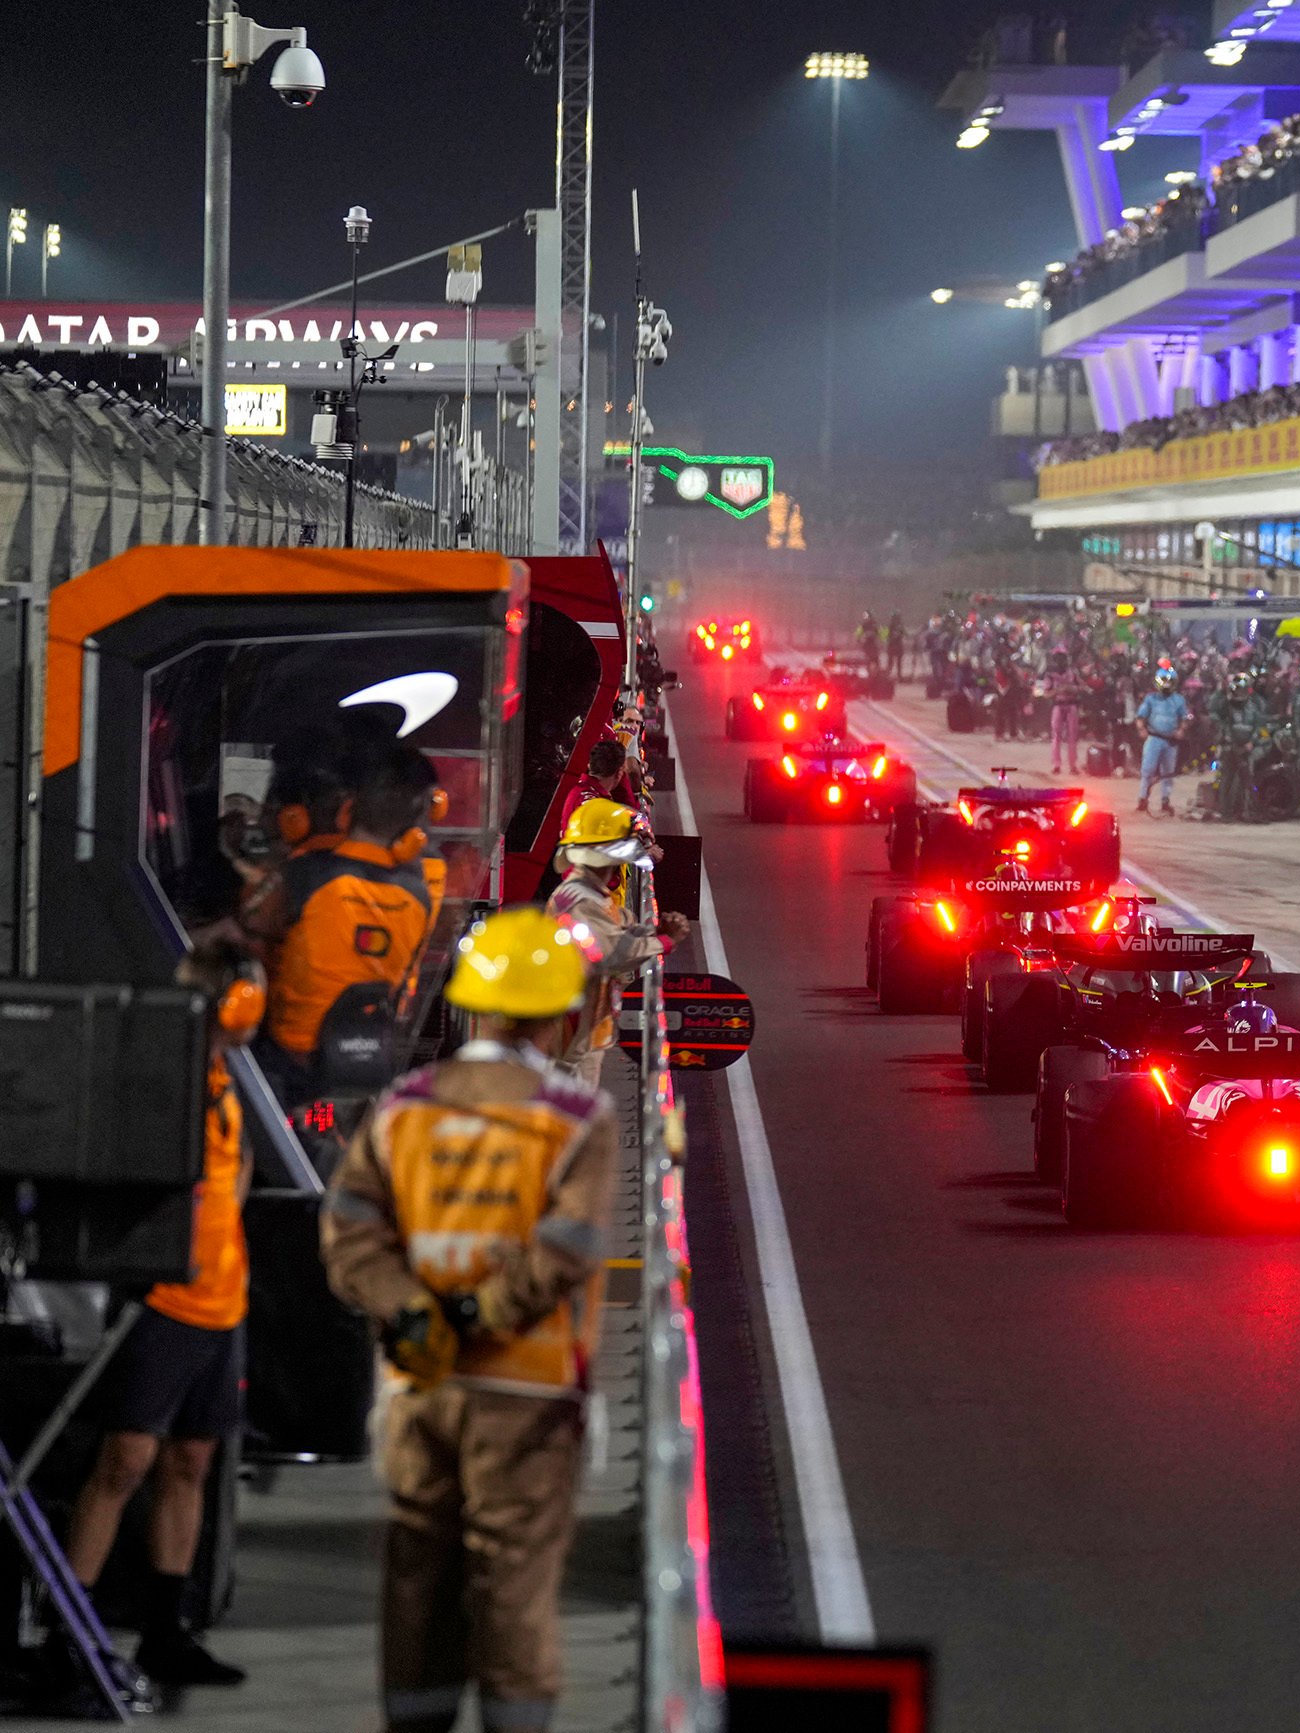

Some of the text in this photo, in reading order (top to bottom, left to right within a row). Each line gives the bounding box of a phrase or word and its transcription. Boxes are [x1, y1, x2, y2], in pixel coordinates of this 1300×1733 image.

[0, 314, 160, 348] ATAR
[975, 880, 1081, 892] COINPAYMENTS
[1115, 935, 1223, 952] Valvoline
[683, 1005, 751, 1016] ORACLE
